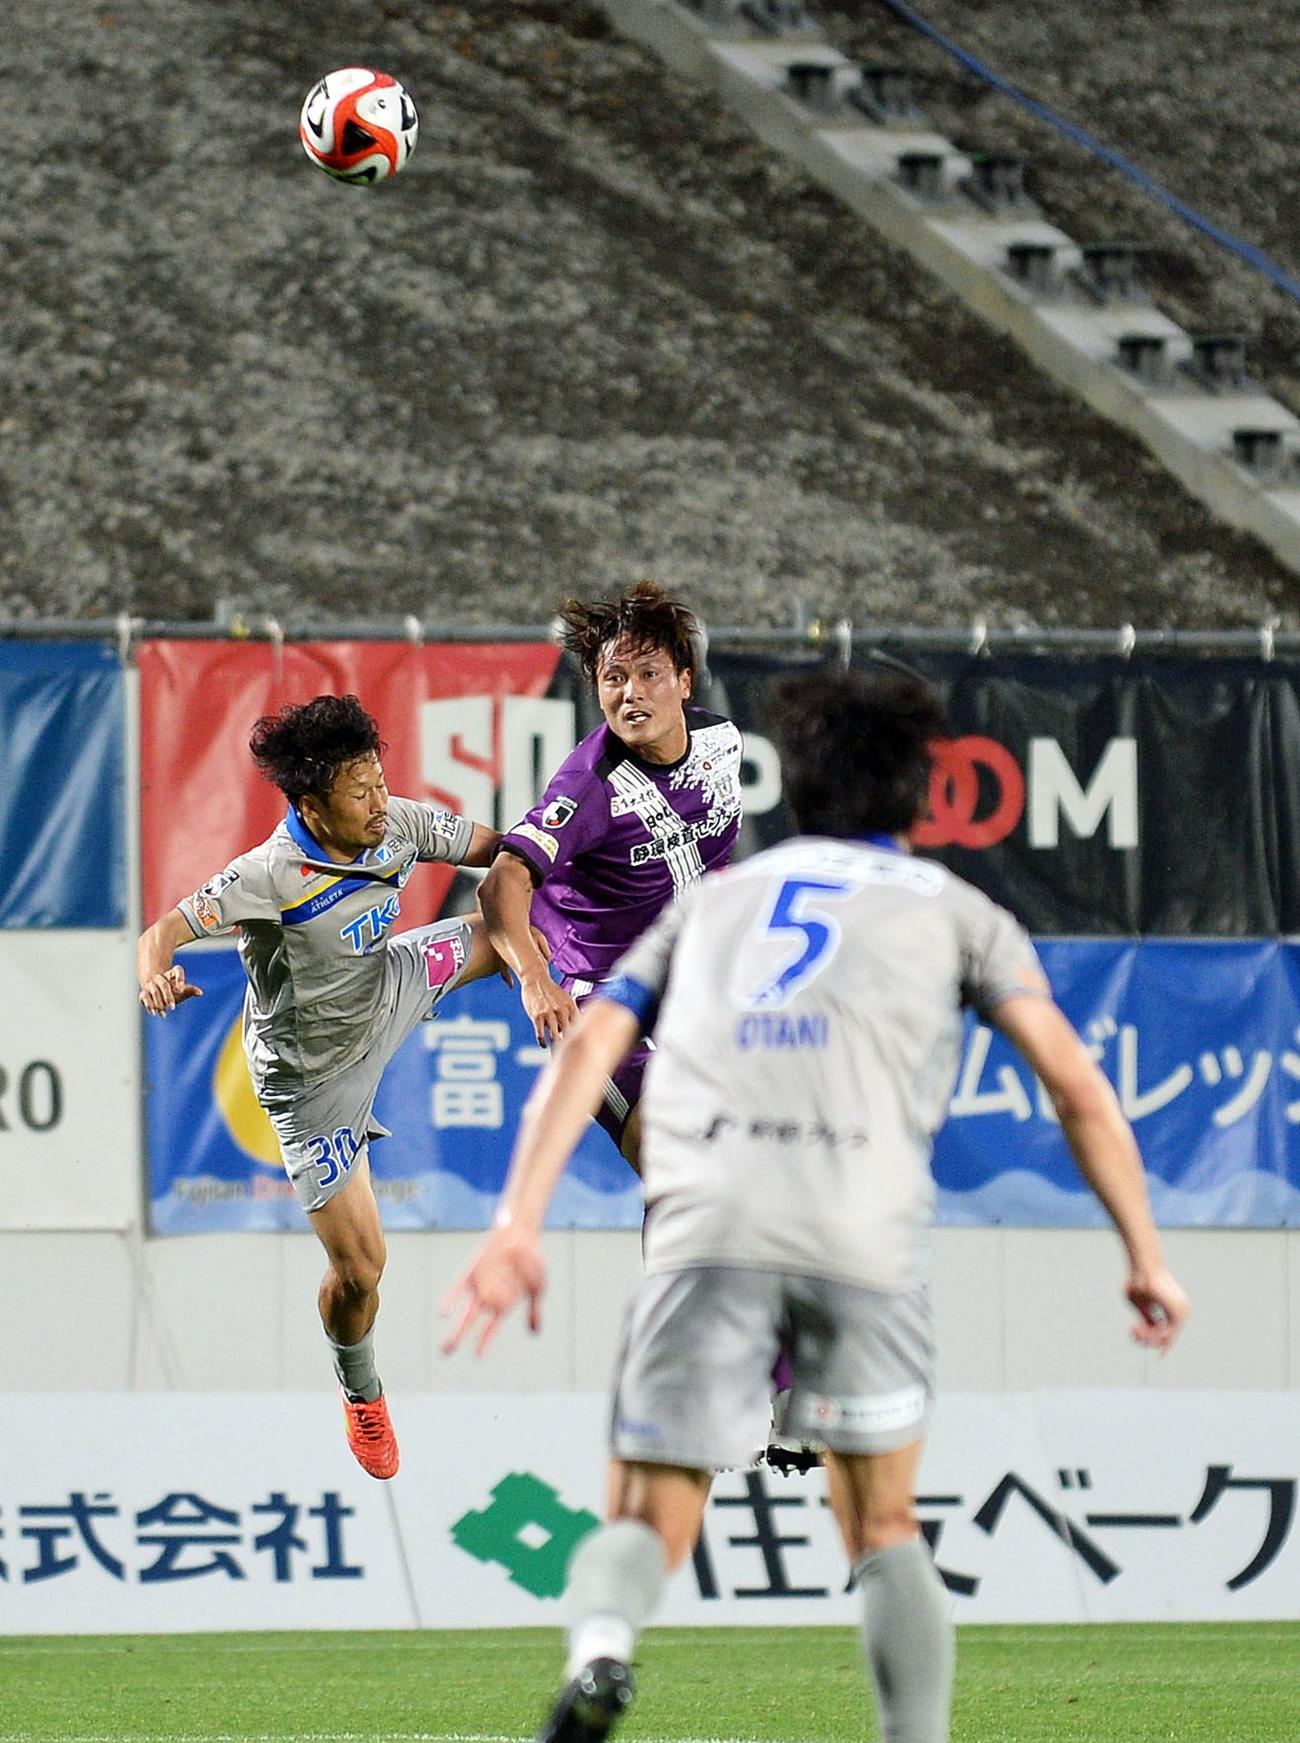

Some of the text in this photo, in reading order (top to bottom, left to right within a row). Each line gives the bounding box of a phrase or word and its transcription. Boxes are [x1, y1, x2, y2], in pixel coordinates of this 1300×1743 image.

[311, 889, 344, 914] ATHLETA
[735, 875, 860, 1008] 5
[735, 1012, 829, 1050] OTANI
[305, 1126, 359, 1188] 30
[0, 1491, 364, 1584] 式会社
